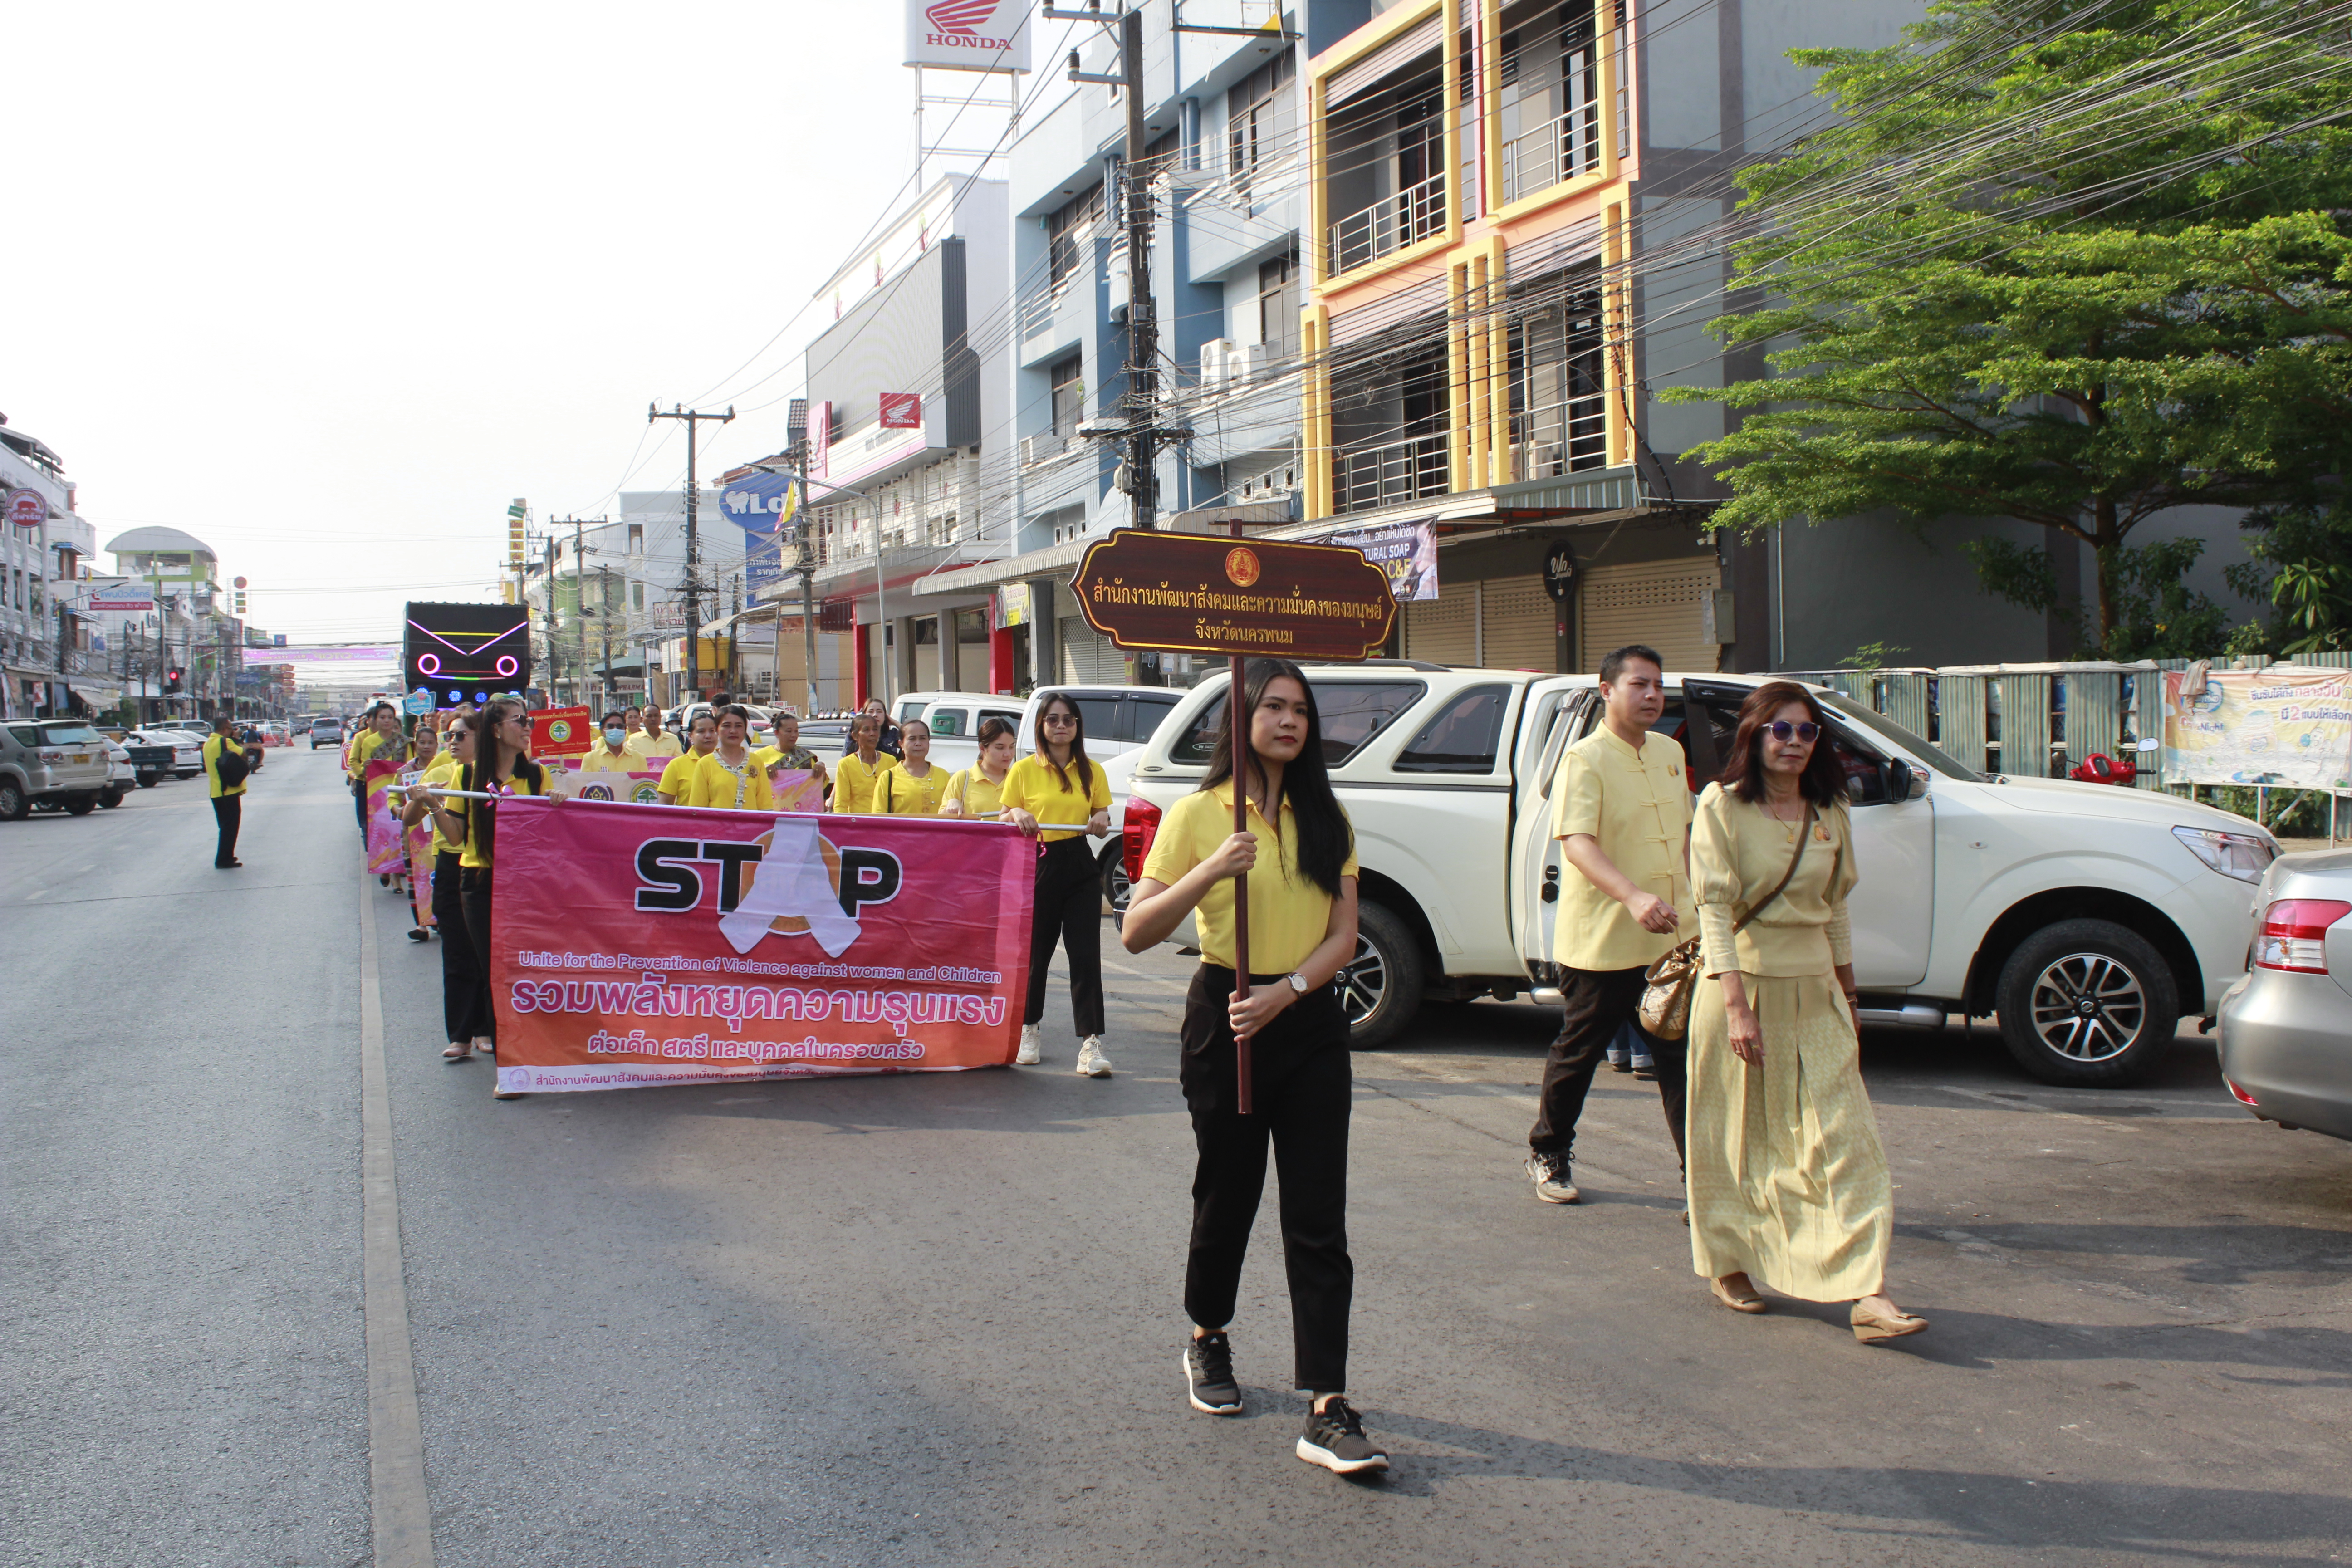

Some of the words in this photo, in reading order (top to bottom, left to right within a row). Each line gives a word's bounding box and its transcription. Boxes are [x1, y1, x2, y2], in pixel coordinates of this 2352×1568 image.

[926, 33, 1014, 50] HONDA
[1362, 546, 1388, 561] TURAL
[1389, 543, 1410, 559] SOAP
[1093, 577, 1382, 628] สำนักงานพัฒนาสังคมและความมั่นคงของมนุษย์
[1195, 617, 1293, 644] จังหวัดนครพนม
[2295, 681, 2341, 698] กลางวัน
[534, 710, 587, 721] ลุ่มออมทรัพย์เพื่อการผลิต
[2281, 707, 2289, 720] มี
[2290, 706, 2300, 720] 2
[2301, 707, 2351, 720] แบบให้เลือก
[519, 951, 563, 968] Unite
[564, 952, 587, 968] for
[588, 953, 615, 969] the
[617, 954, 701, 971] Prevention
[702, 956, 721, 972] of
[722, 957, 788, 975] Violence
[791, 963, 848, 979] against
[849, 965, 905, 980] women
[906, 966, 936, 981] and
[937, 965, 1002, 984] Children
[511, 971, 1006, 1037] รวมพลังหยุดความรุนแรง
[588, 1029, 658, 1056] ต่อเด็ก
[661, 1033, 708, 1058] สตรี
[712, 1035, 926, 1065] และบุคคลในครอบครัว
